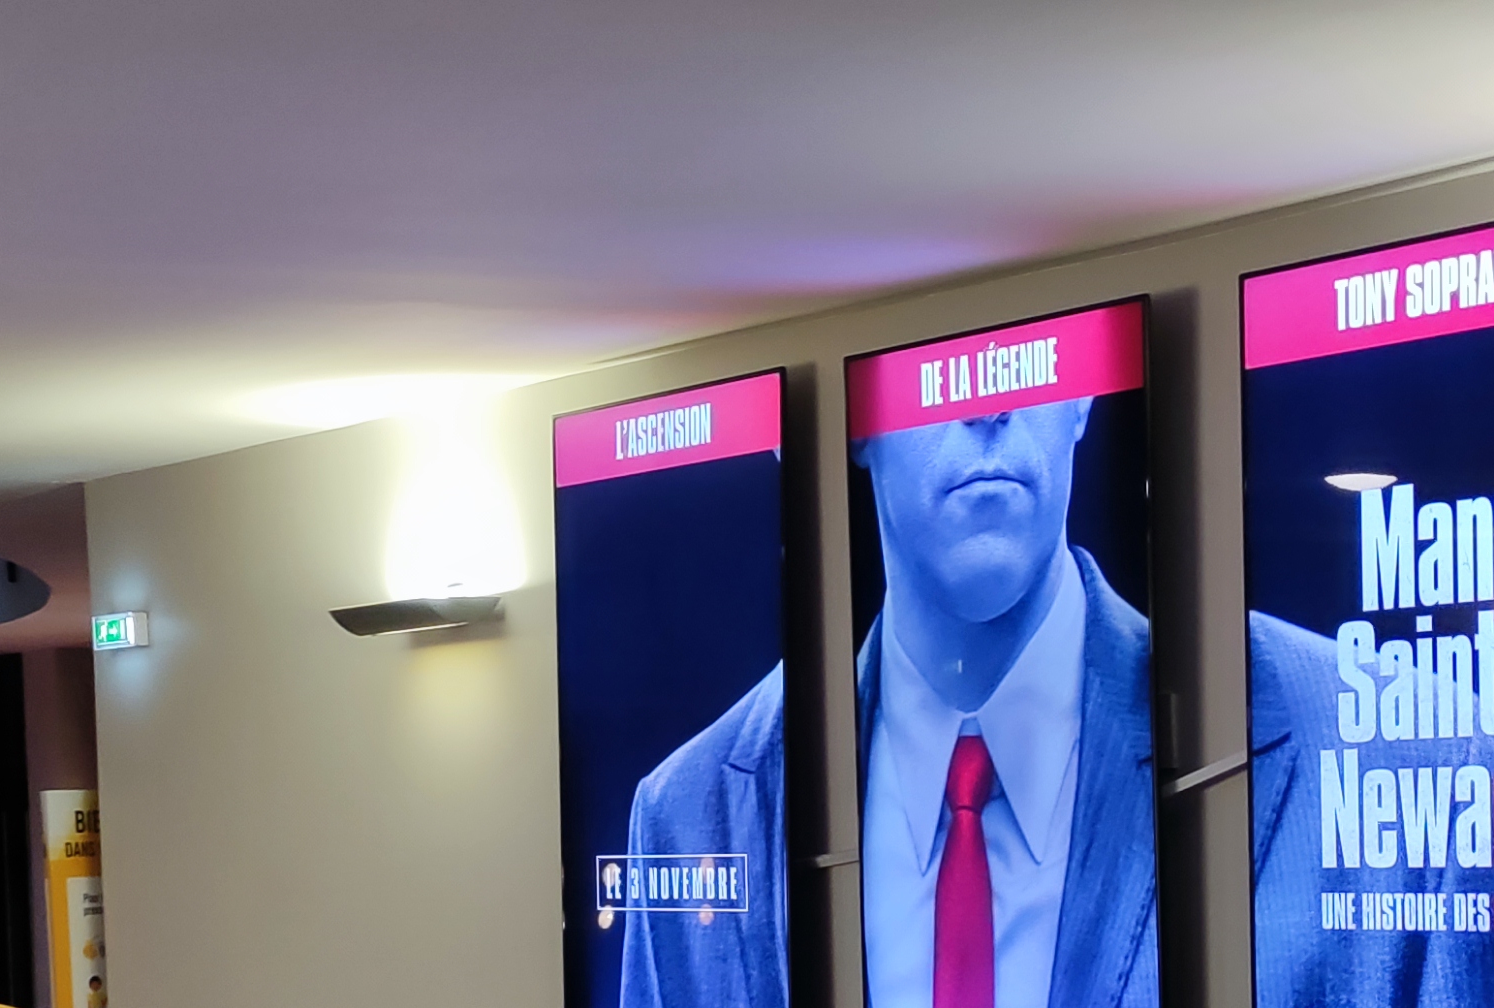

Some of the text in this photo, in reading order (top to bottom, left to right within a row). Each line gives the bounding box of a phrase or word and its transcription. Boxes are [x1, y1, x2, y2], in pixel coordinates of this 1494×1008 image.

[1335, 268, 1399, 331] TONY
[920, 336, 1059, 408] DE LA LÉGENDE
[615, 402, 712, 460] L'ASCENSION
[606, 867, 738, 900] LE 3 NOVEMBRE
[1321, 892, 1357, 930] UNE
[1362, 892, 1448, 931] HISTOIRE
[1453, 893, 1491, 932] DES
